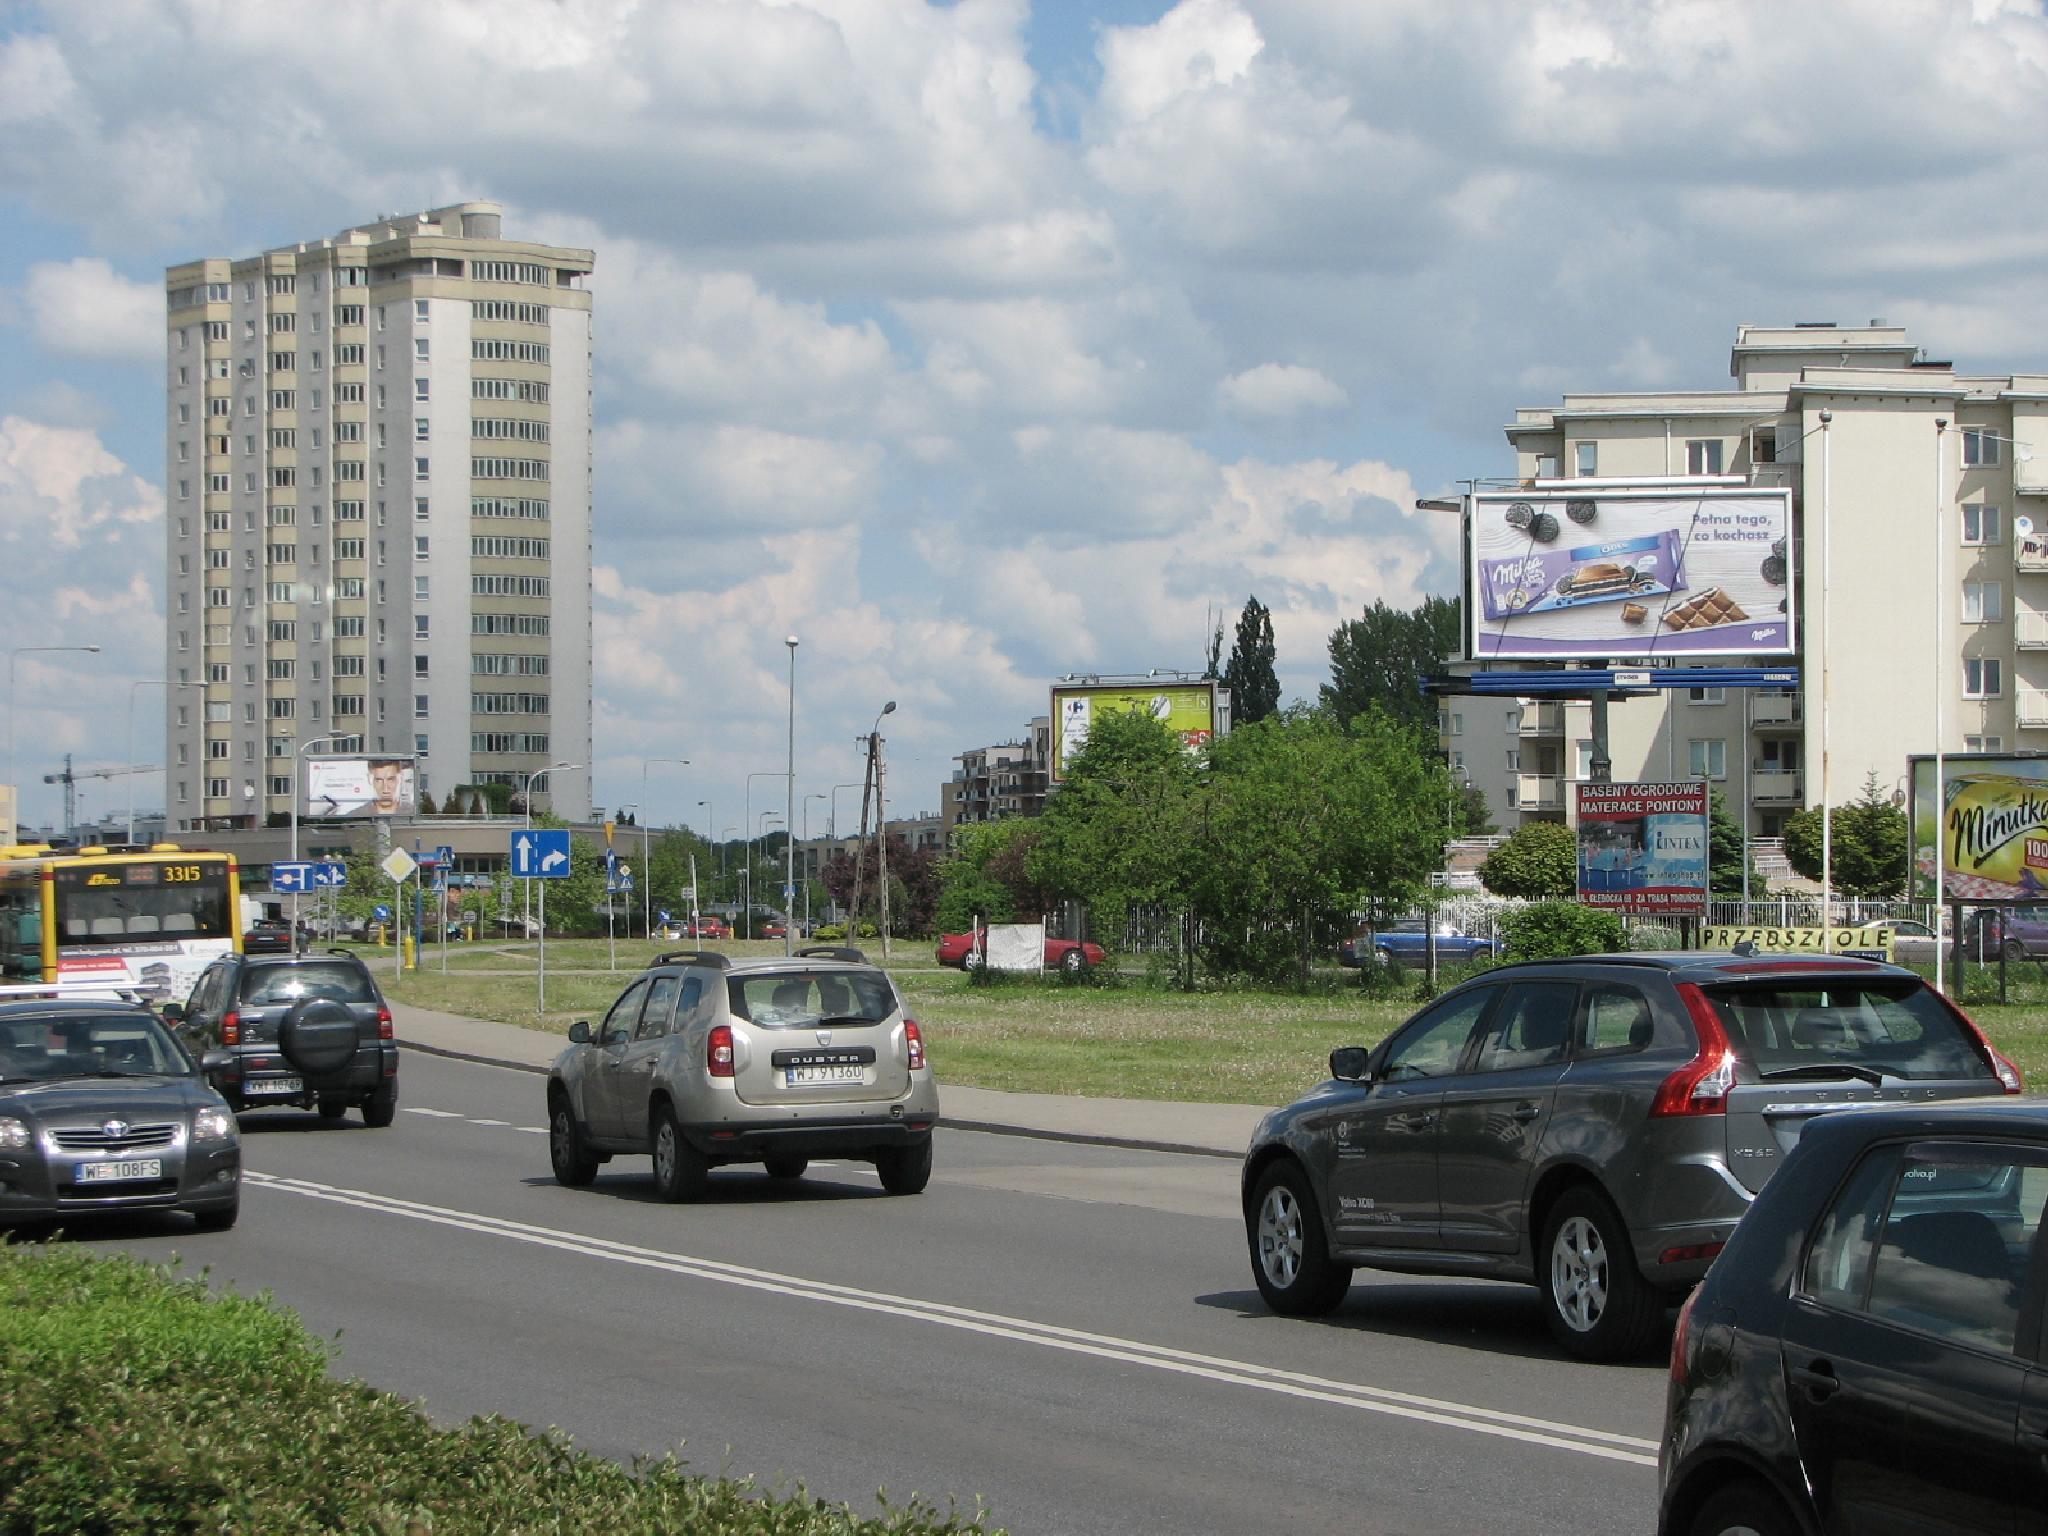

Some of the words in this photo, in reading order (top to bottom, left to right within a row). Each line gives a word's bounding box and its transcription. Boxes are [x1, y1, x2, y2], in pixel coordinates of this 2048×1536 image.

[1736, 514, 1772, 527] tego,
[1694, 532, 1710, 541] co
[1713, 528, 1769, 541] kochasz
[1493, 555, 1545, 585] Milka
[1582, 784, 1628, 798] BASENY
[1630, 783, 1703, 797] OGRODOWE
[1580, 801, 1642, 813] MATERACE
[1646, 800, 1704, 812] PONTONY
[1656, 832, 1701, 850] INTEX
[163, 865, 201, 881] 3315
[1635, 893, 1645, 903] ZA
[791, 1055, 859, 1064] DUSTER
[113, 1161, 160, 1178] 108FS
